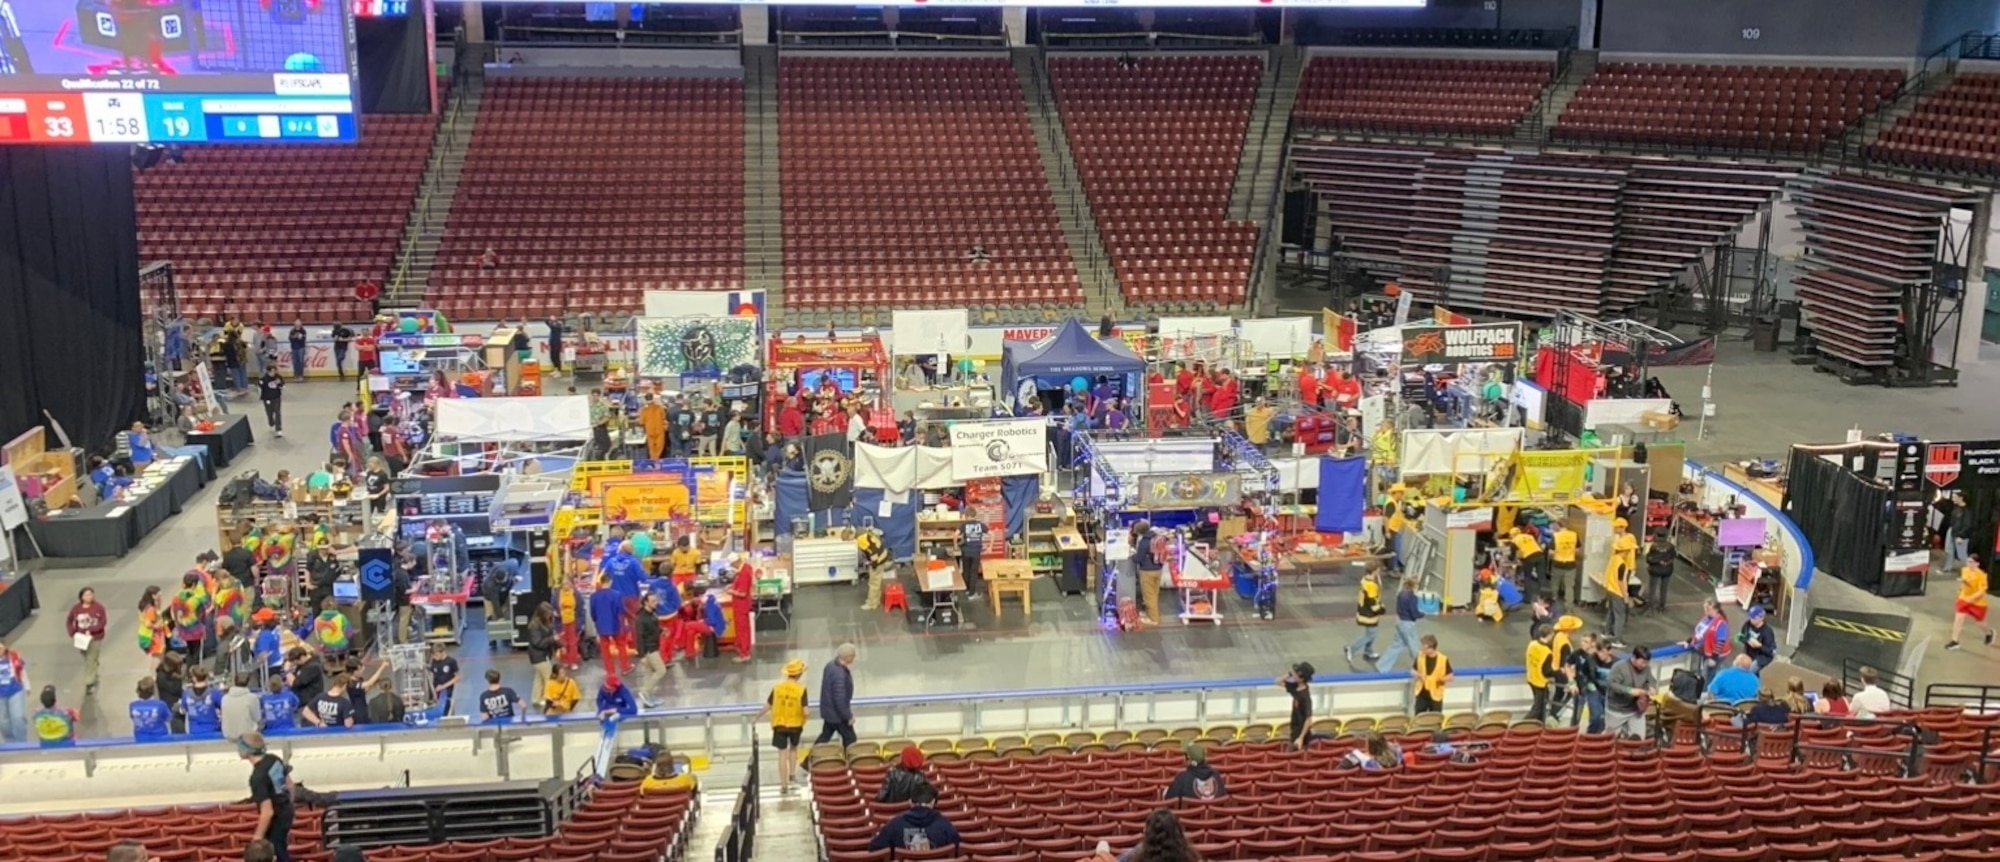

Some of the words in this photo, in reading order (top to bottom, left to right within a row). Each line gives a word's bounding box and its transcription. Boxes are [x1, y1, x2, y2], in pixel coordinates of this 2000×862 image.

[1742, 28, 1760, 39] 109
[62, 79, 120, 90] Qualification
[121, 79, 134, 89] 22
[135, 79, 145, 89] of
[146, 79, 160, 90] 72
[45, 117, 74, 137] 33
[96, 118, 140, 135] 1:58
[162, 117, 190, 137] 19
[288, 121, 313, 132] 0/4
[1445, 328, 1514, 345] WOLFPACK
[1445, 345, 1494, 357] ROBOTICS
[956, 430, 994, 440] Charger
[997, 428, 1037, 438] Robotics
[973, 465, 998, 473] Team
[1000, 462, 1023, 471] 5071
[1968, 458, 1994, 466] BLACK
[1151, 481, 1168, 500] 45
[1213, 480, 1227, 499] 50
[621, 496, 640, 504] Team
[317, 700, 338, 715] 5071
[403, 712, 427, 725] 071
